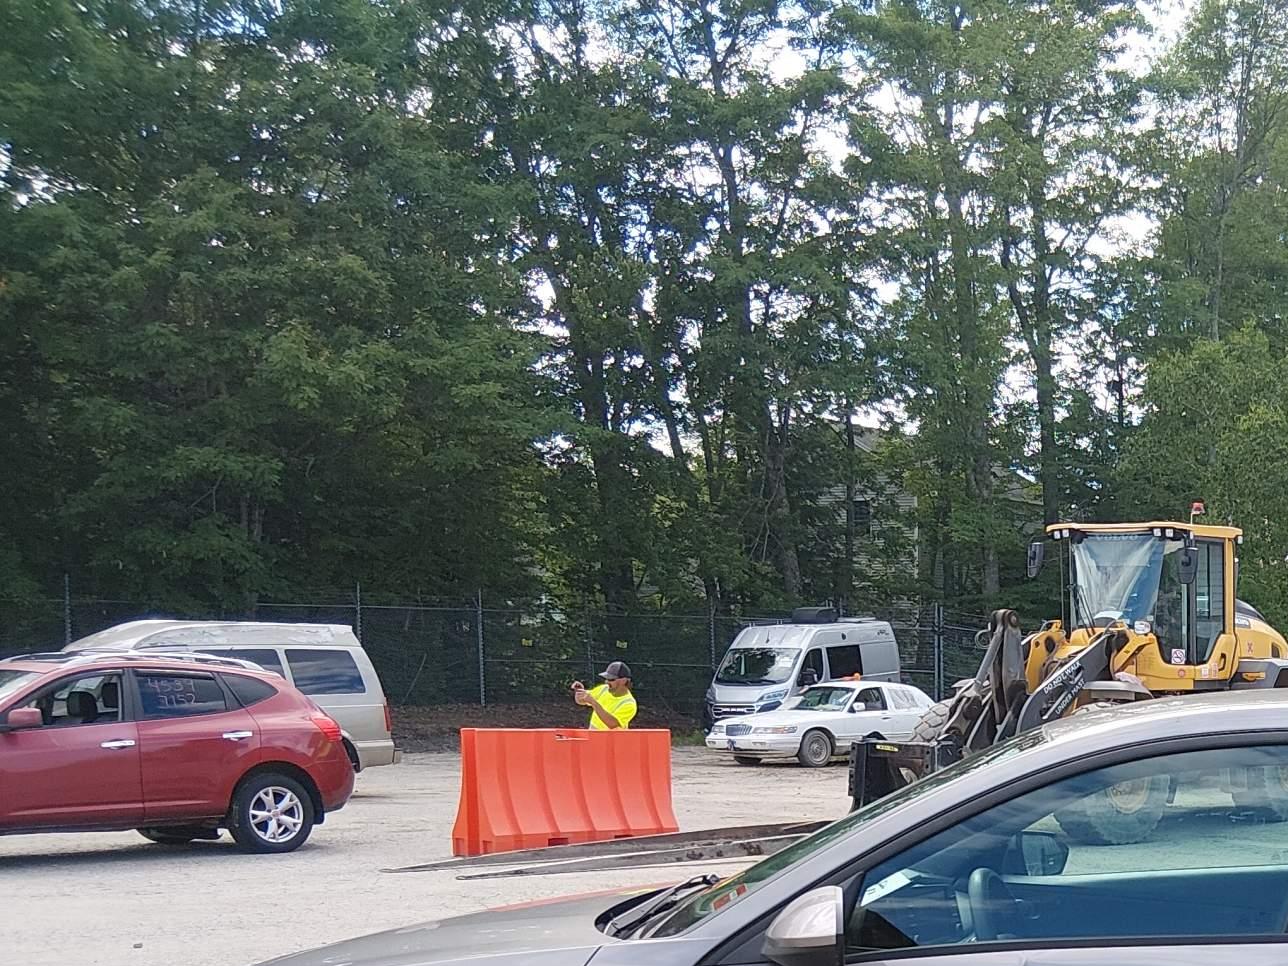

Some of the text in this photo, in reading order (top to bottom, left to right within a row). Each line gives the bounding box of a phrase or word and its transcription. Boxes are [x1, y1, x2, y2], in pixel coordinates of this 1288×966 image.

[1043, 660, 1081, 694] DO NOT WALK
[1055, 679, 1085, 714] UNDER MAST
